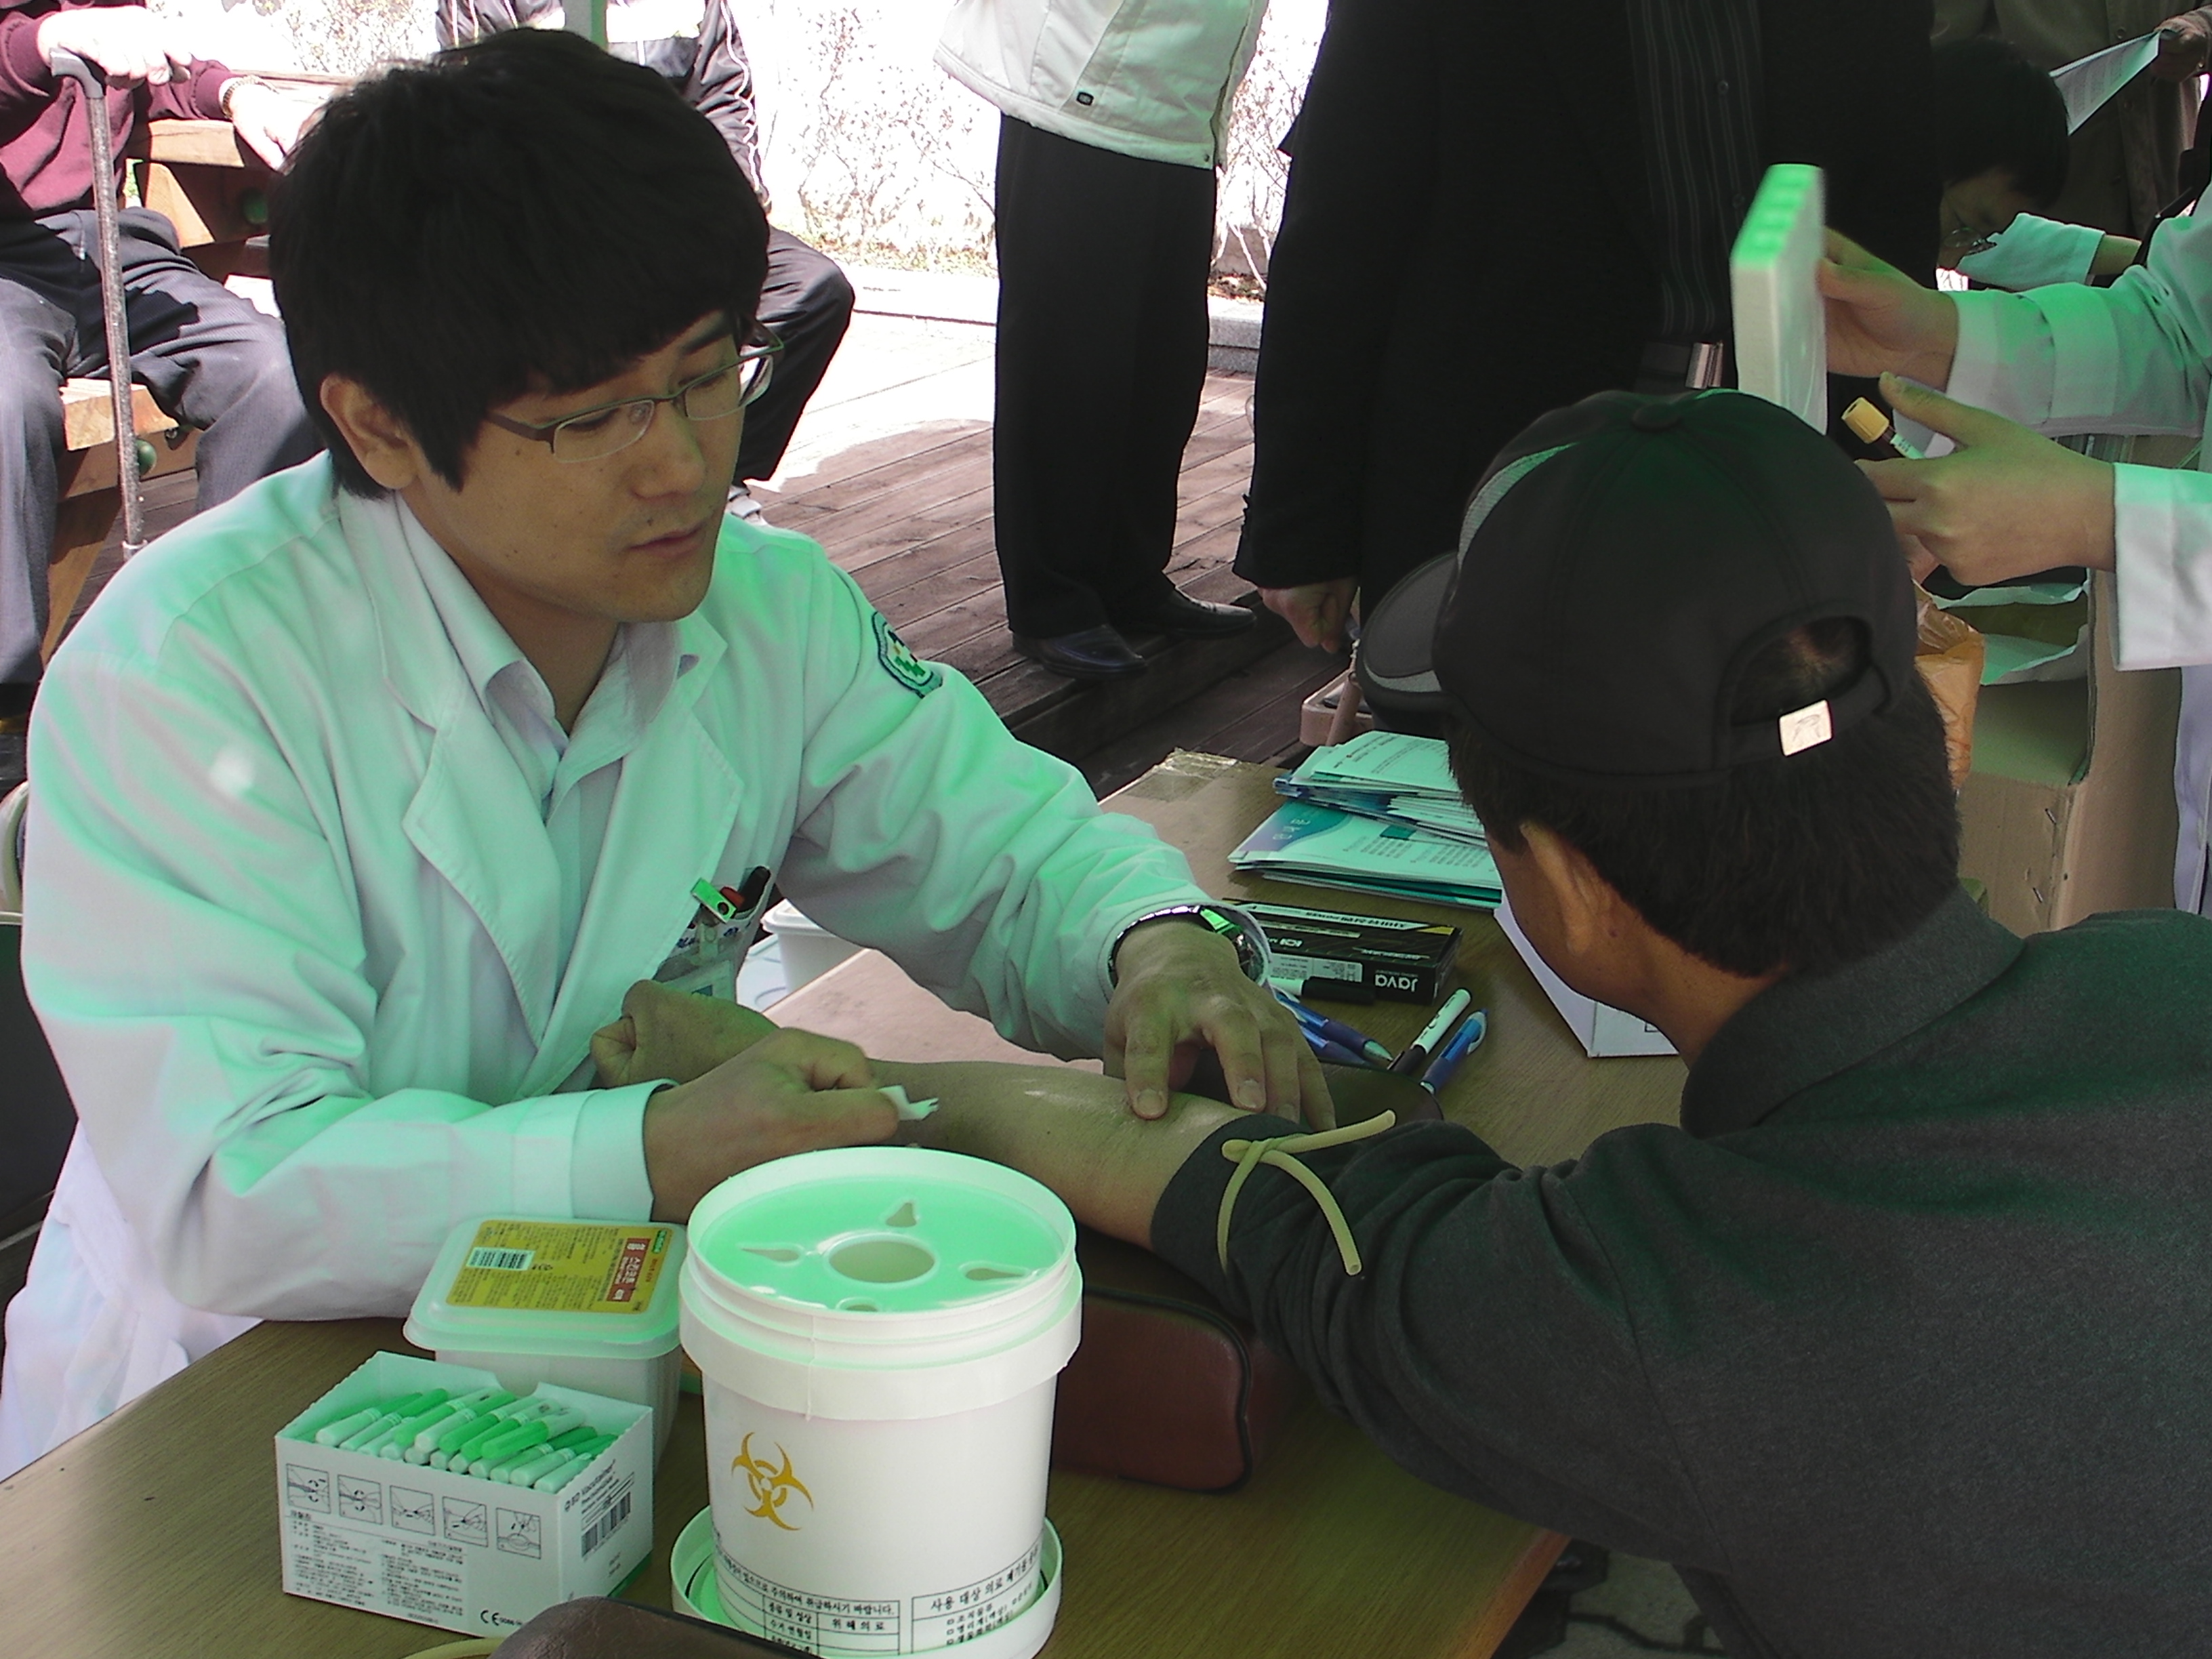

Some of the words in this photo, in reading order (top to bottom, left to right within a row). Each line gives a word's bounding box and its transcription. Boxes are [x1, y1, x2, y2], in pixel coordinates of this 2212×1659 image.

[1374, 974, 1418, 992] Java
[930, 1596, 955, 1612] 사용
[959, 1586, 981, 1605] 대상
[985, 1576, 1004, 1595] 의료
